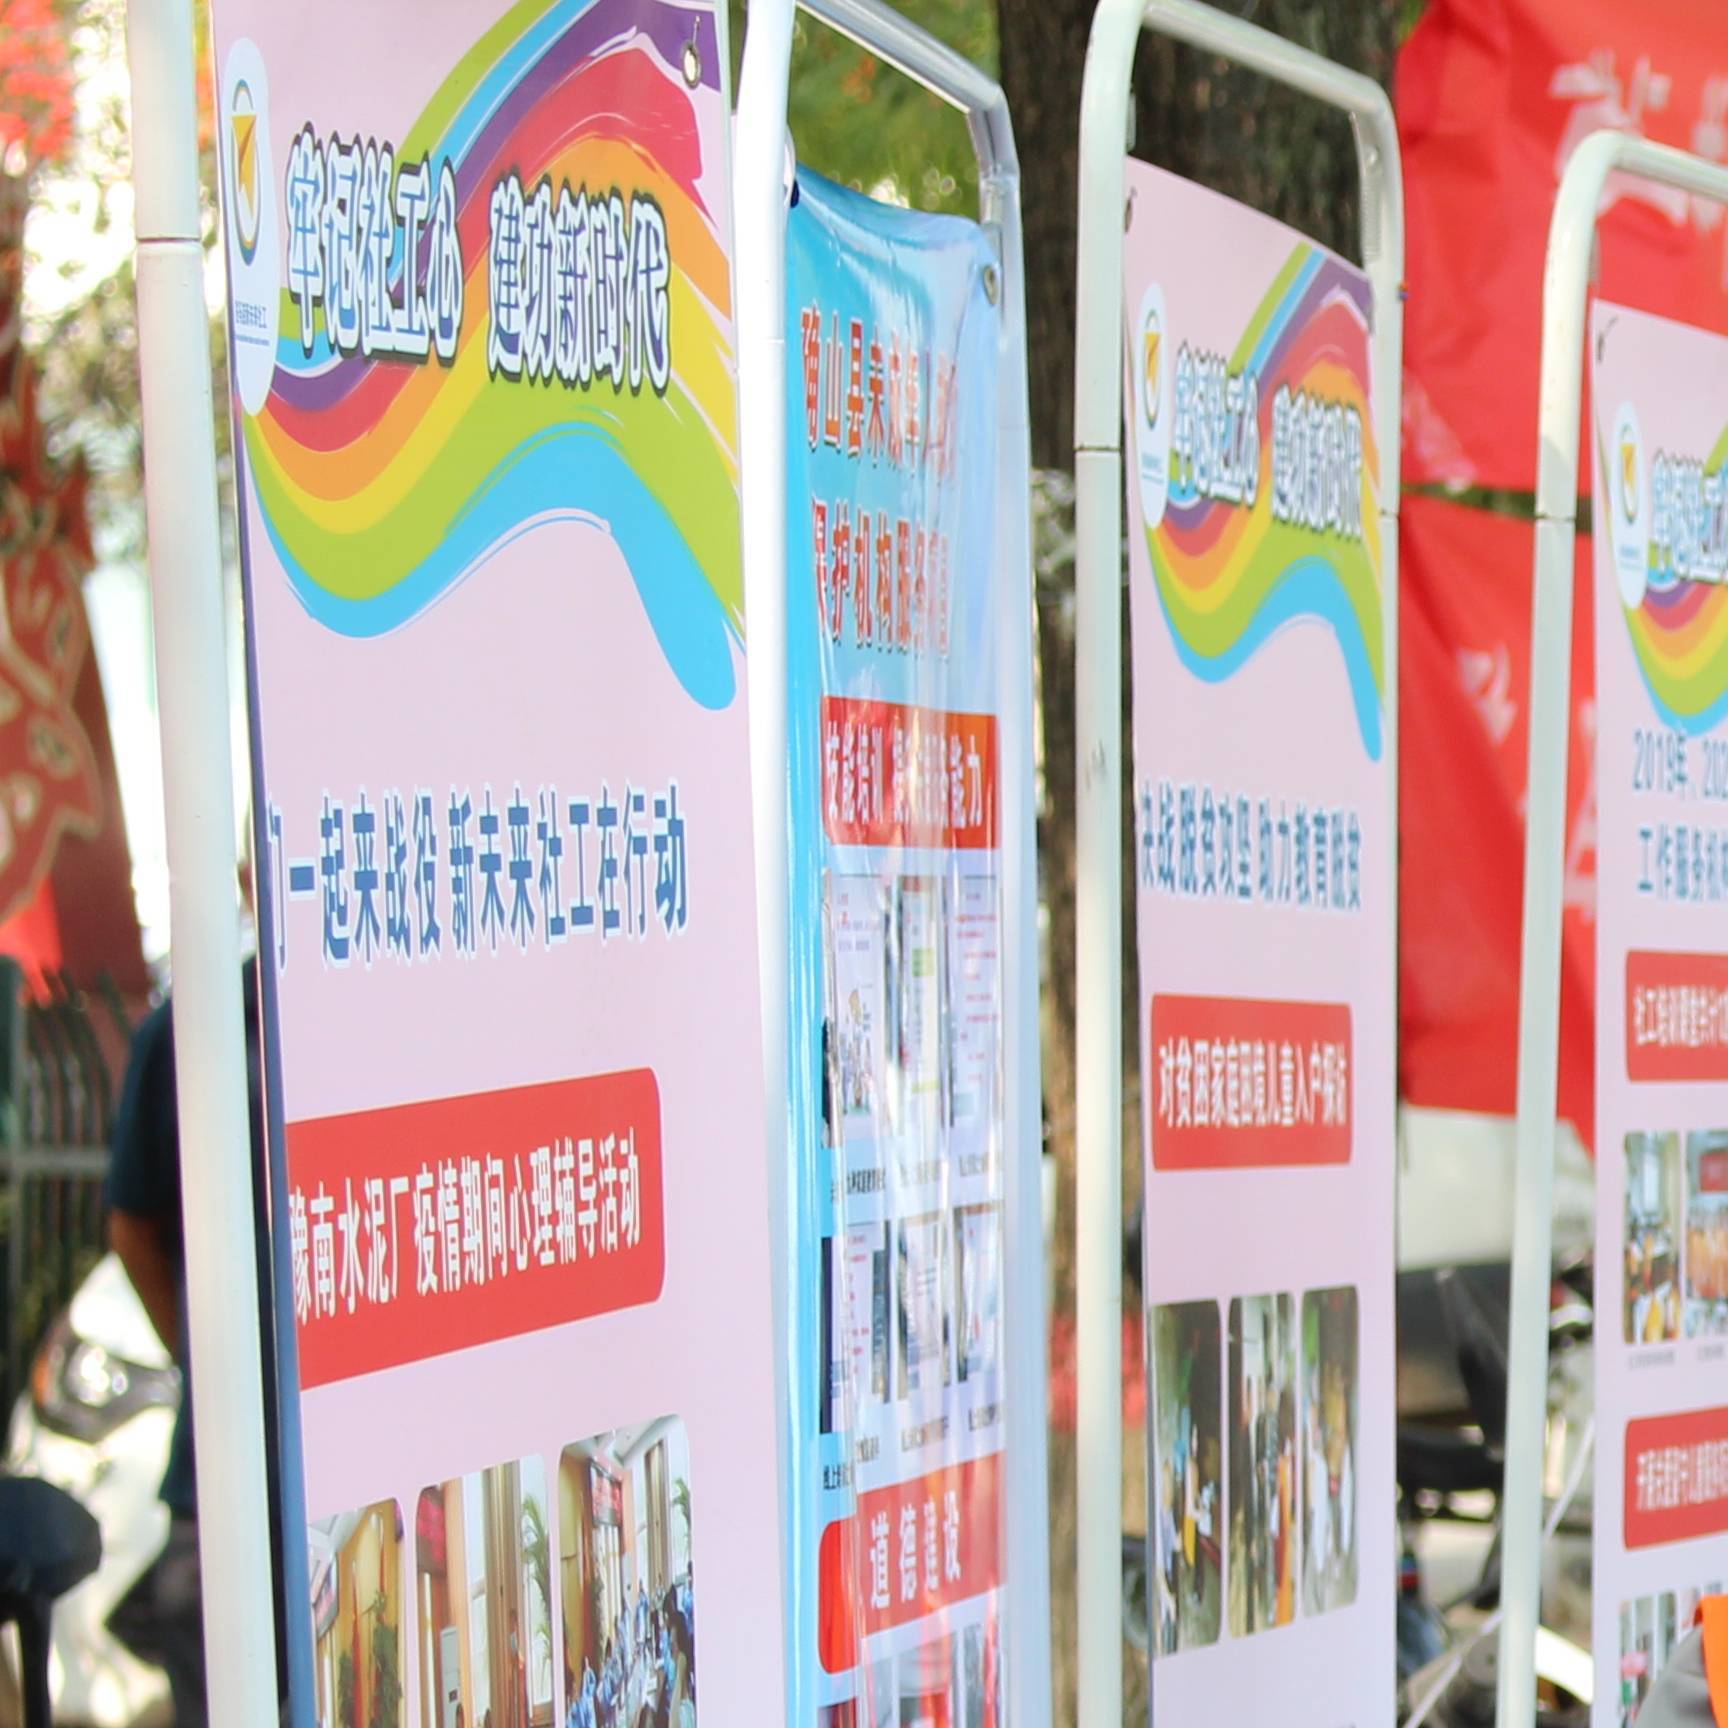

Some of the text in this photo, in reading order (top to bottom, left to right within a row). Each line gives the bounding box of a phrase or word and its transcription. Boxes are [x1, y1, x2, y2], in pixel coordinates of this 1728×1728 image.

[487, 166, 670, 400] 建功新时代
[449, 778, 690, 955] 新未来社工在行动
